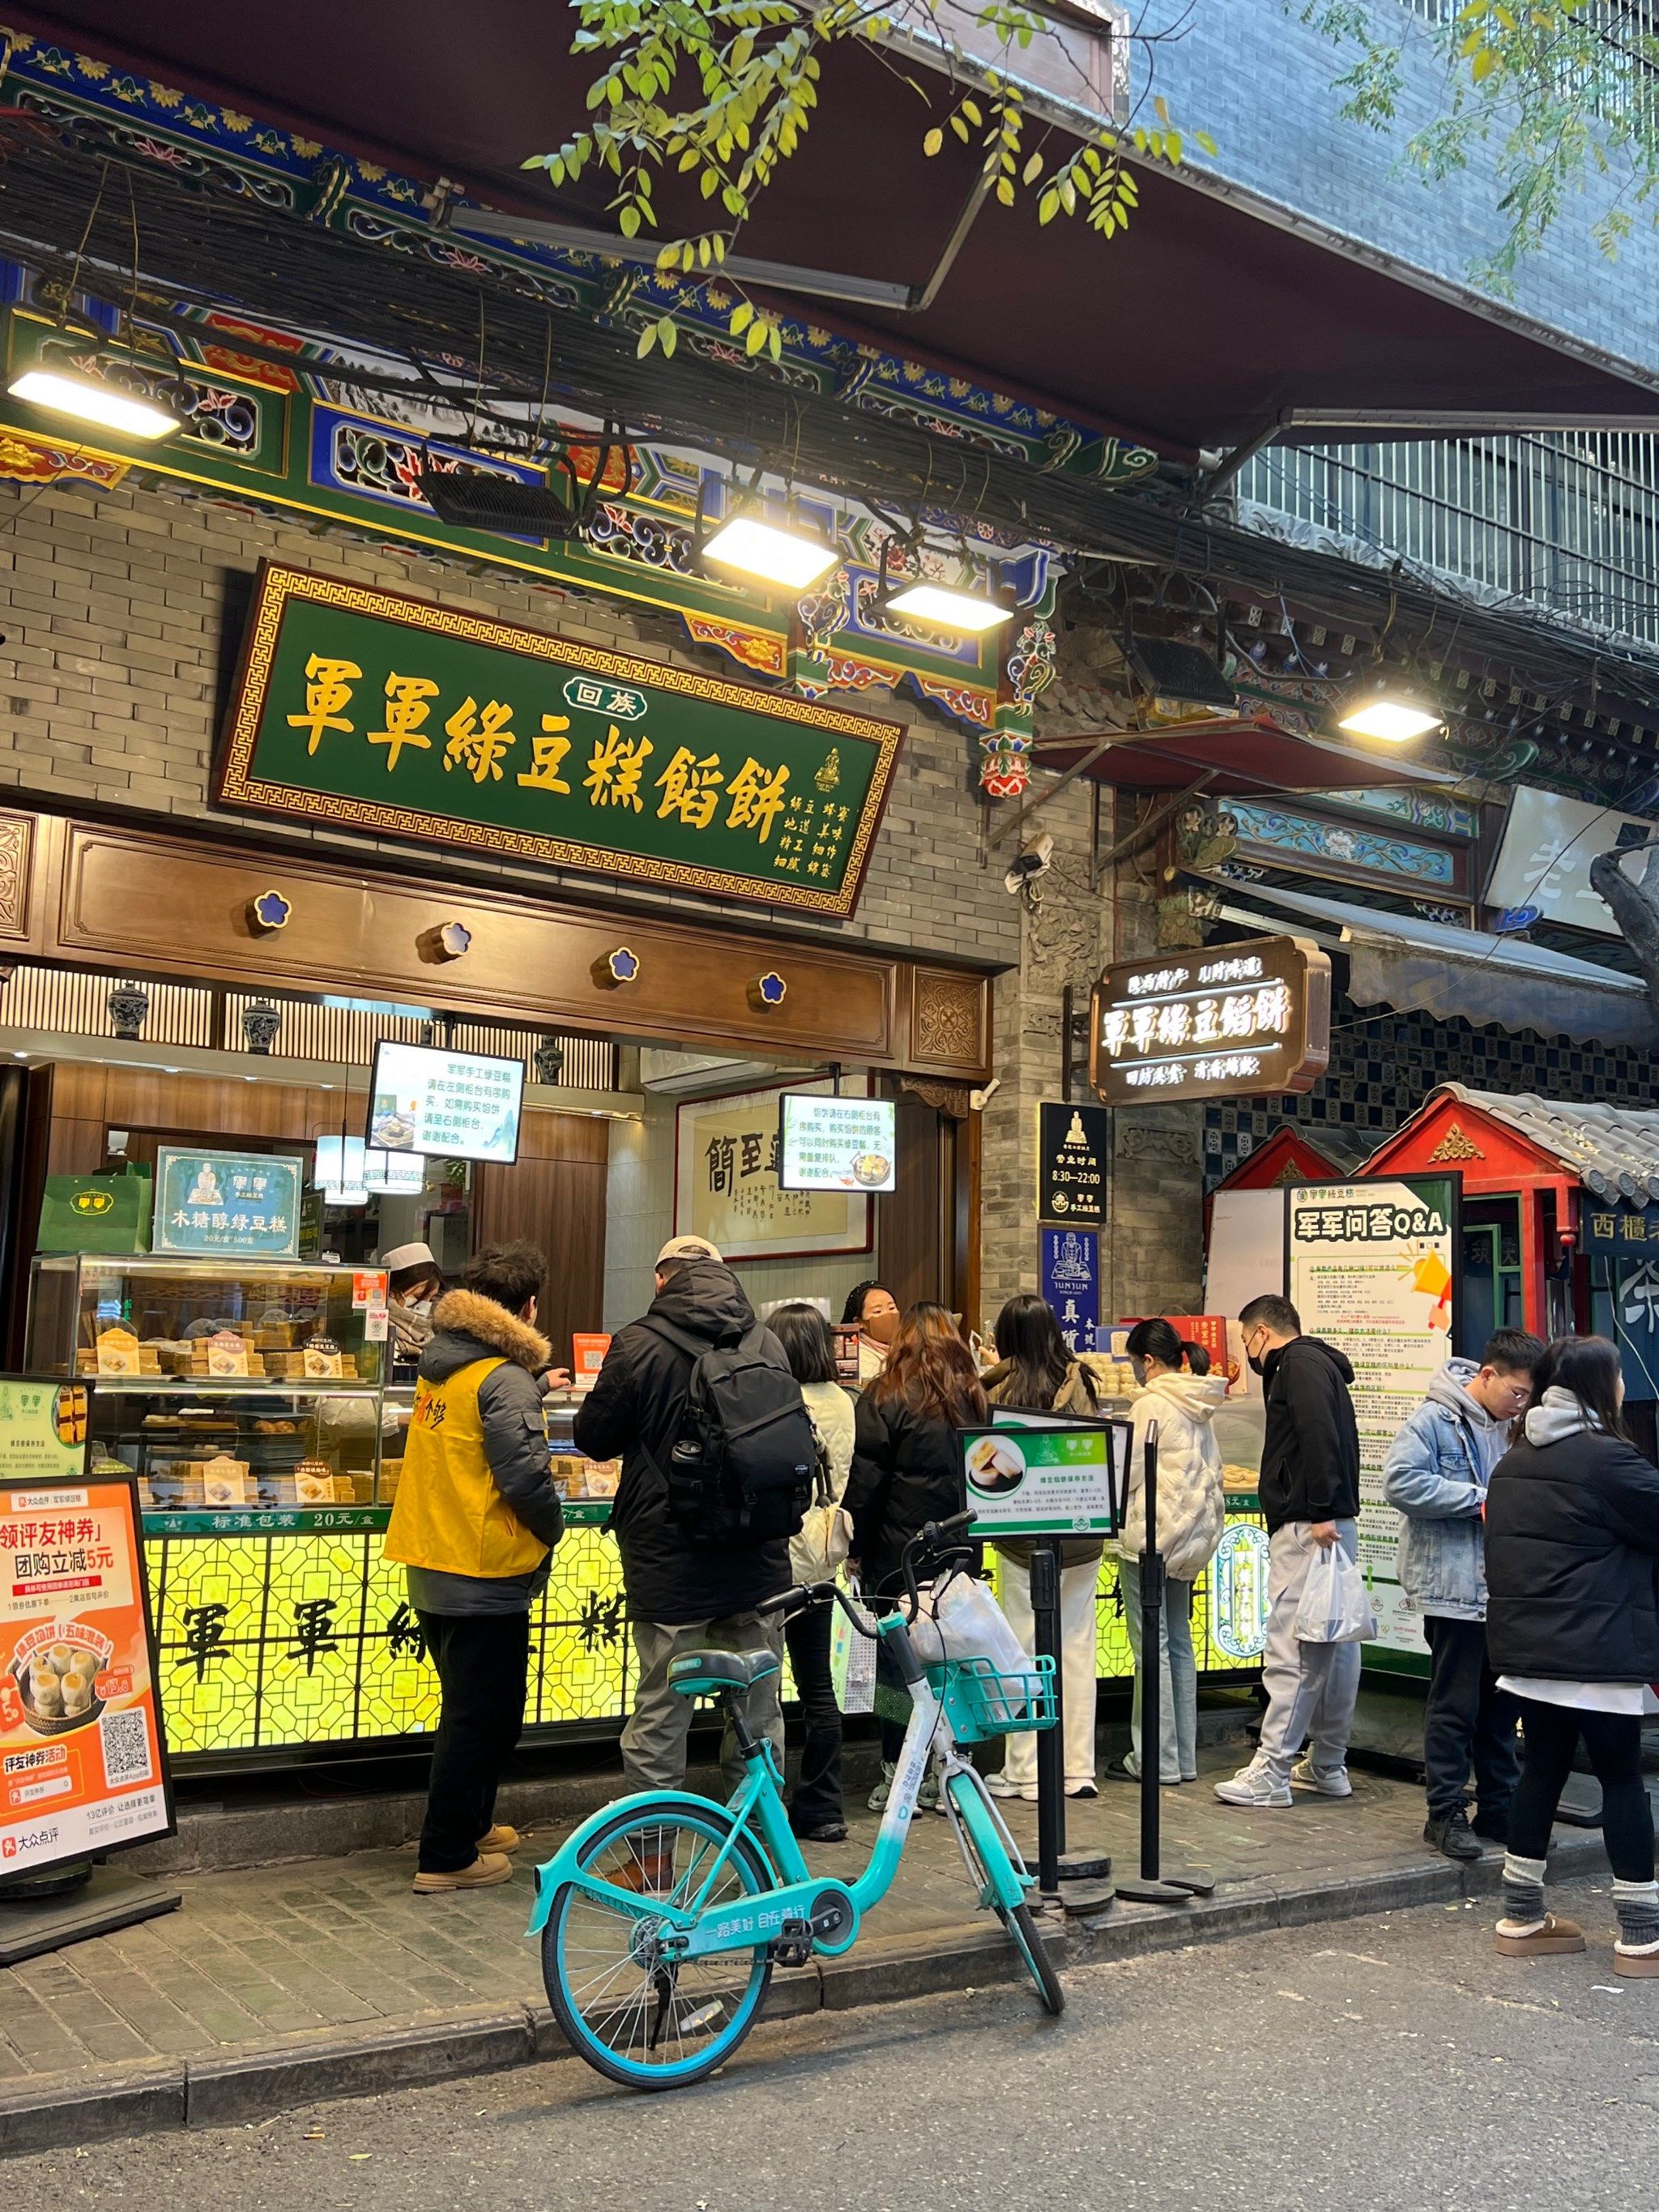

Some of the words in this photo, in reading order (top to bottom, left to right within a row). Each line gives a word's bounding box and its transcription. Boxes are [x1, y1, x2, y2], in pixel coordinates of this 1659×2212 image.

[577, 682, 638, 716] 回族
[784, 817, 810, 835] 地道
[817, 822, 842, 841] 美味
[779, 835, 804, 852] 精工
[447, 1063, 511, 1083] 军军手工绿豆糕
[428, 1078, 510, 1100] 请在左侧柜台有序购
[1056, 1154, 1097, 1167] 营业时间
[171, 1210, 288, 1233] 木糖醇绿豆糕
[1298, 1207, 1444, 1238] 军军问答Q&A
[1590, 1213, 1659, 1241] 西櫃
[233, 1236, 254, 1245] 500克
[28, 1497, 49, 1505] 大众点评
[212, 1515, 296, 1529] 标准包装
[313, 1513, 374, 1527] 20元/盒
[15, 1546, 114, 1579] 团购立减5元
[5, 1747, 66, 1772] 评友神券活动
[87, 1806, 115, 1821] 13亿评价
[117, 1794, 156, 1813] 让选择更简单
[19, 1827, 59, 1851] 大众点评
[705, 1918, 754, 1937] 一路美好
